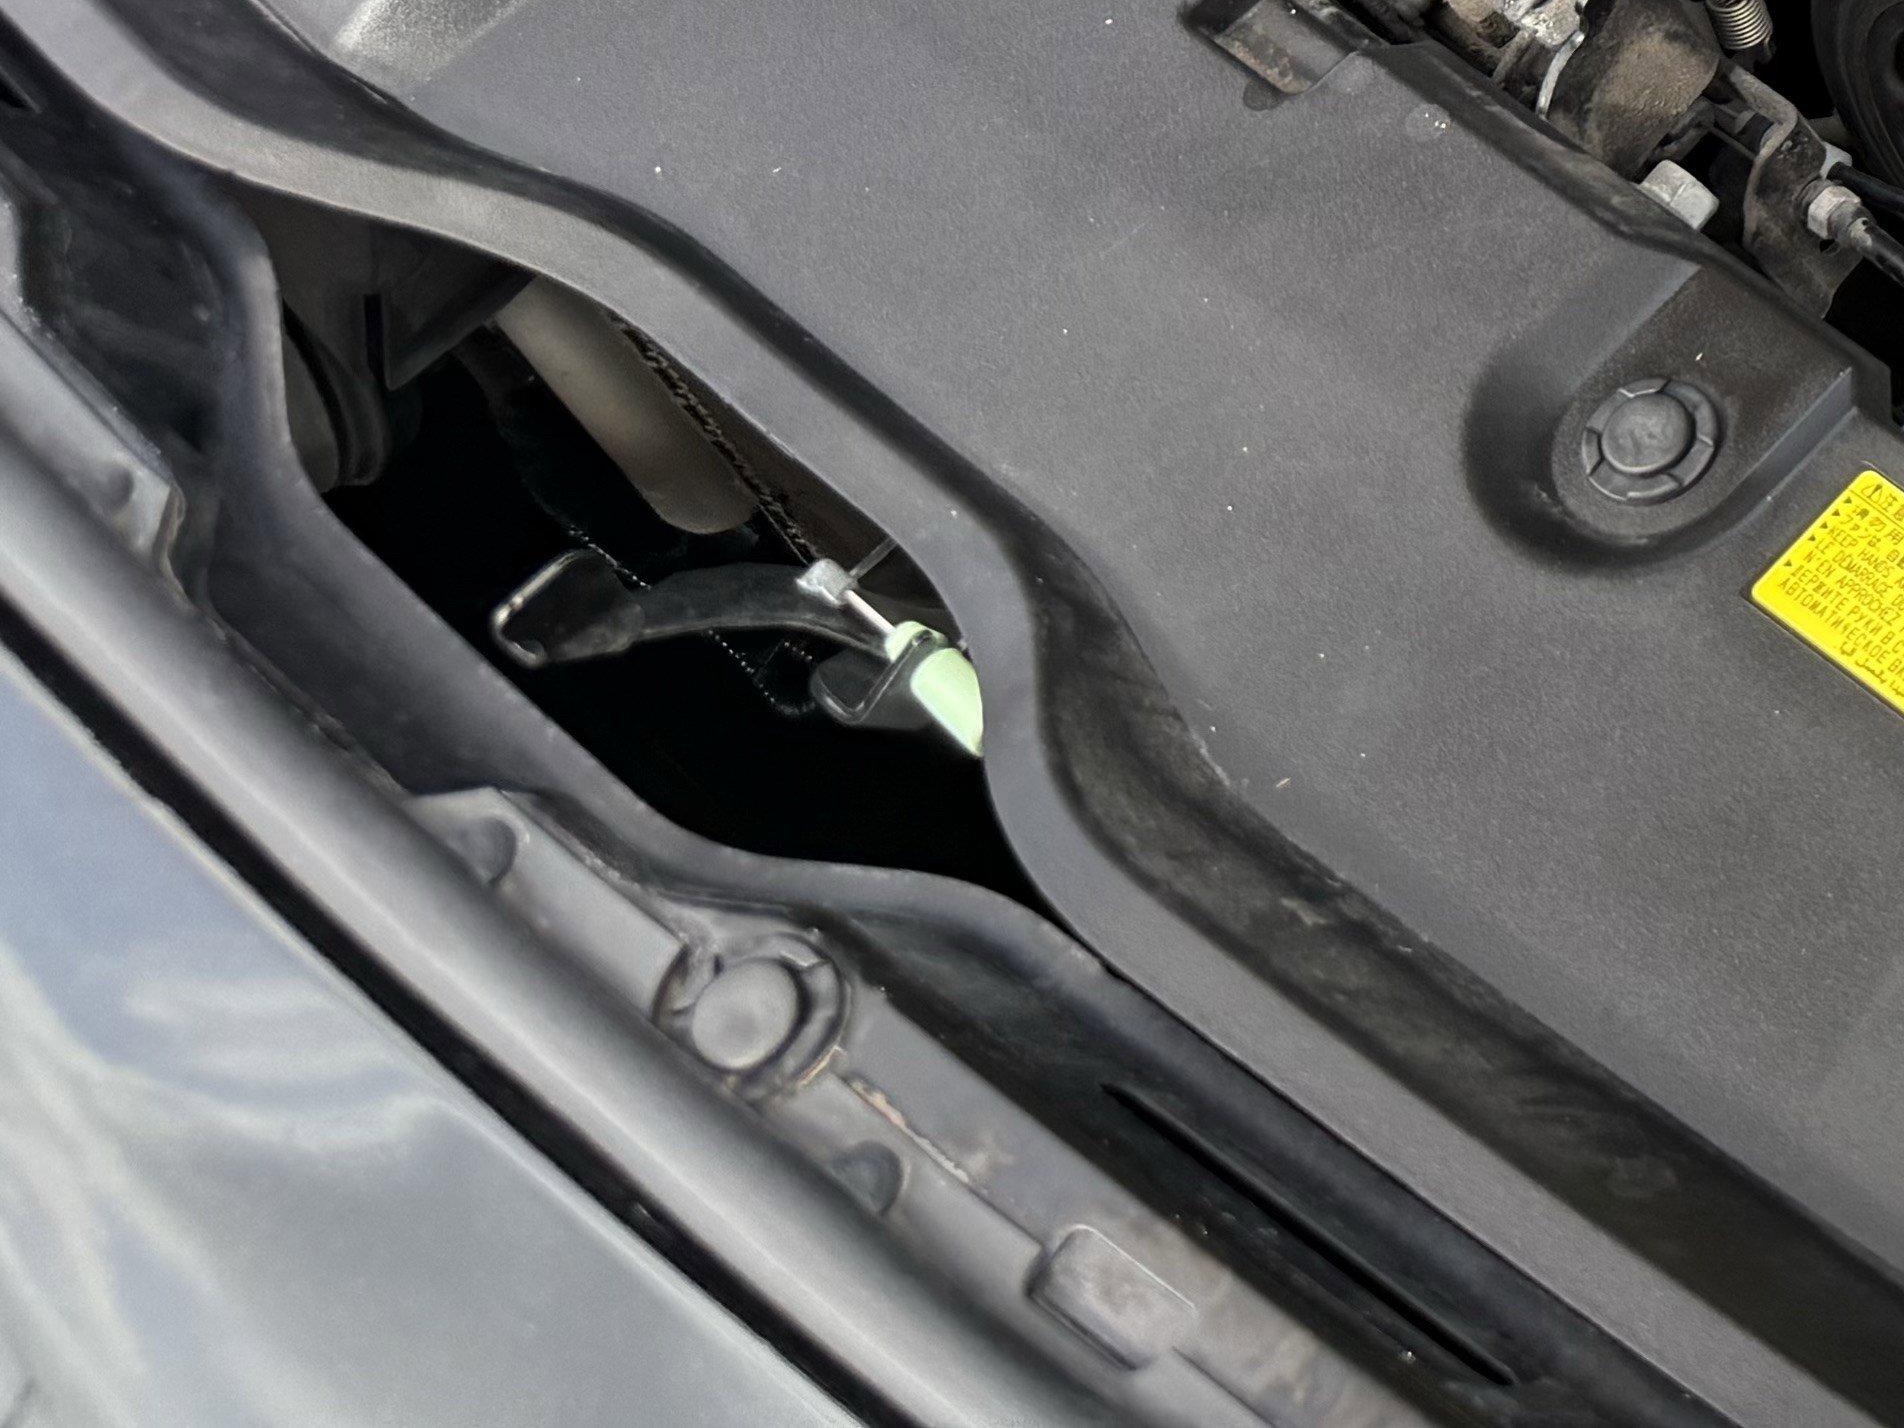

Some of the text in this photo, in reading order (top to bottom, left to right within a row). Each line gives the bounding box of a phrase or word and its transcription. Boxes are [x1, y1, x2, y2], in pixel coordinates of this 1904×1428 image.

[1814, 536, 1832, 553] LE
[1825, 525, 1860, 554] KEEP
[1856, 548, 1894, 579] HANDS
